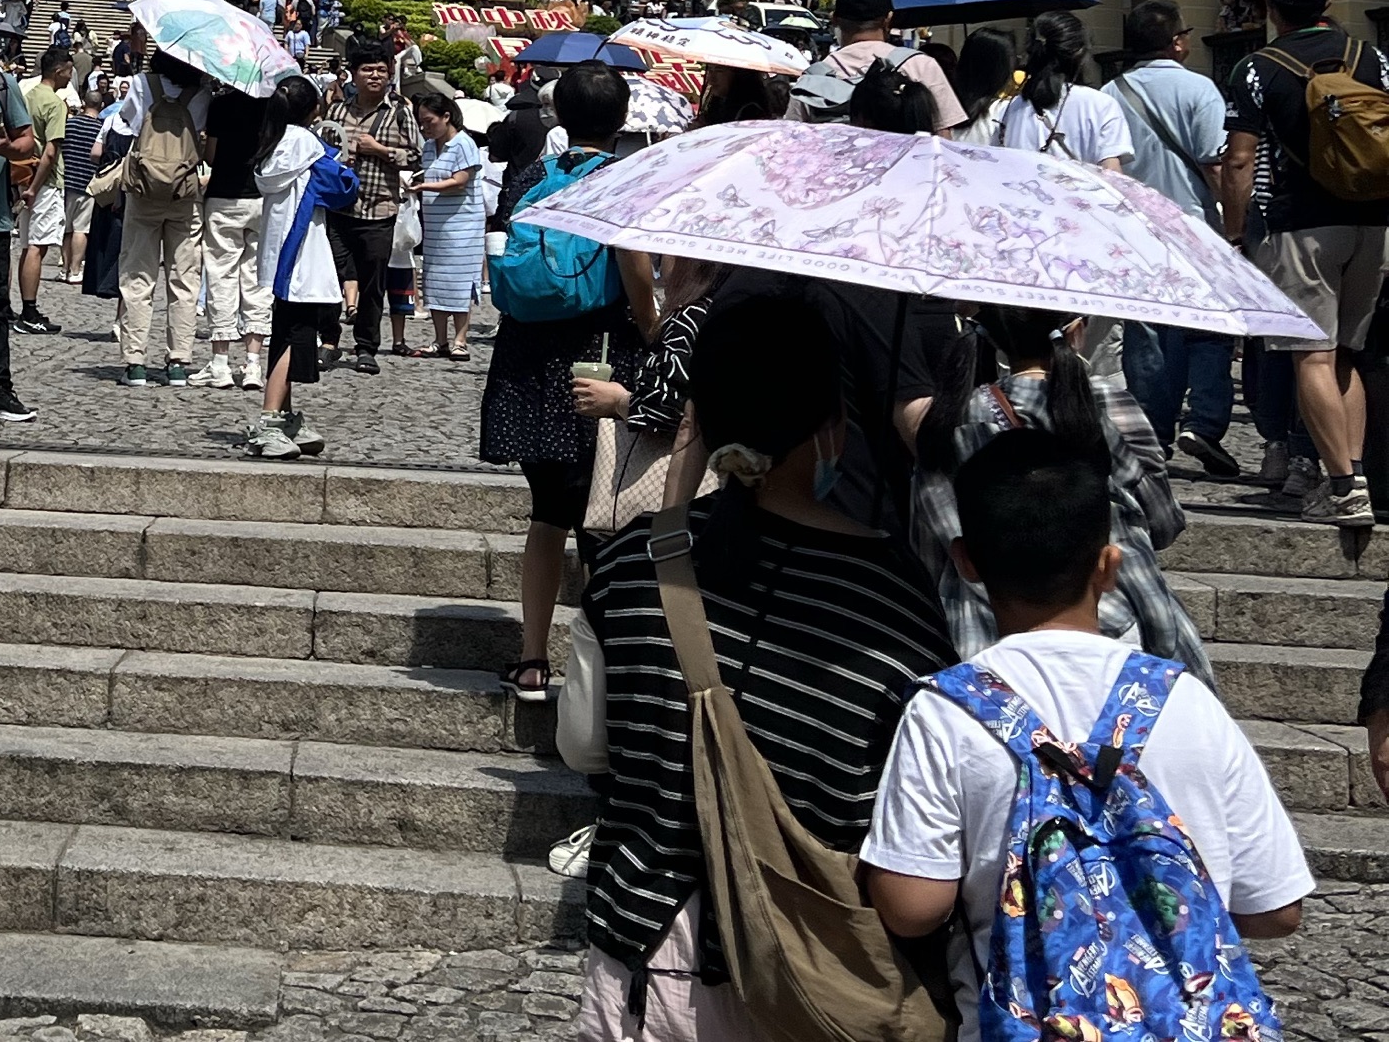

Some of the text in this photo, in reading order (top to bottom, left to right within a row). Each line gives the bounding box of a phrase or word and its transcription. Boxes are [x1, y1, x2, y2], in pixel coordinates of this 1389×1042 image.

[432, 2, 580, 32] 迎中秋
[756, 250, 793, 262] LIFE
[801, 257, 850, 272] GOOD
